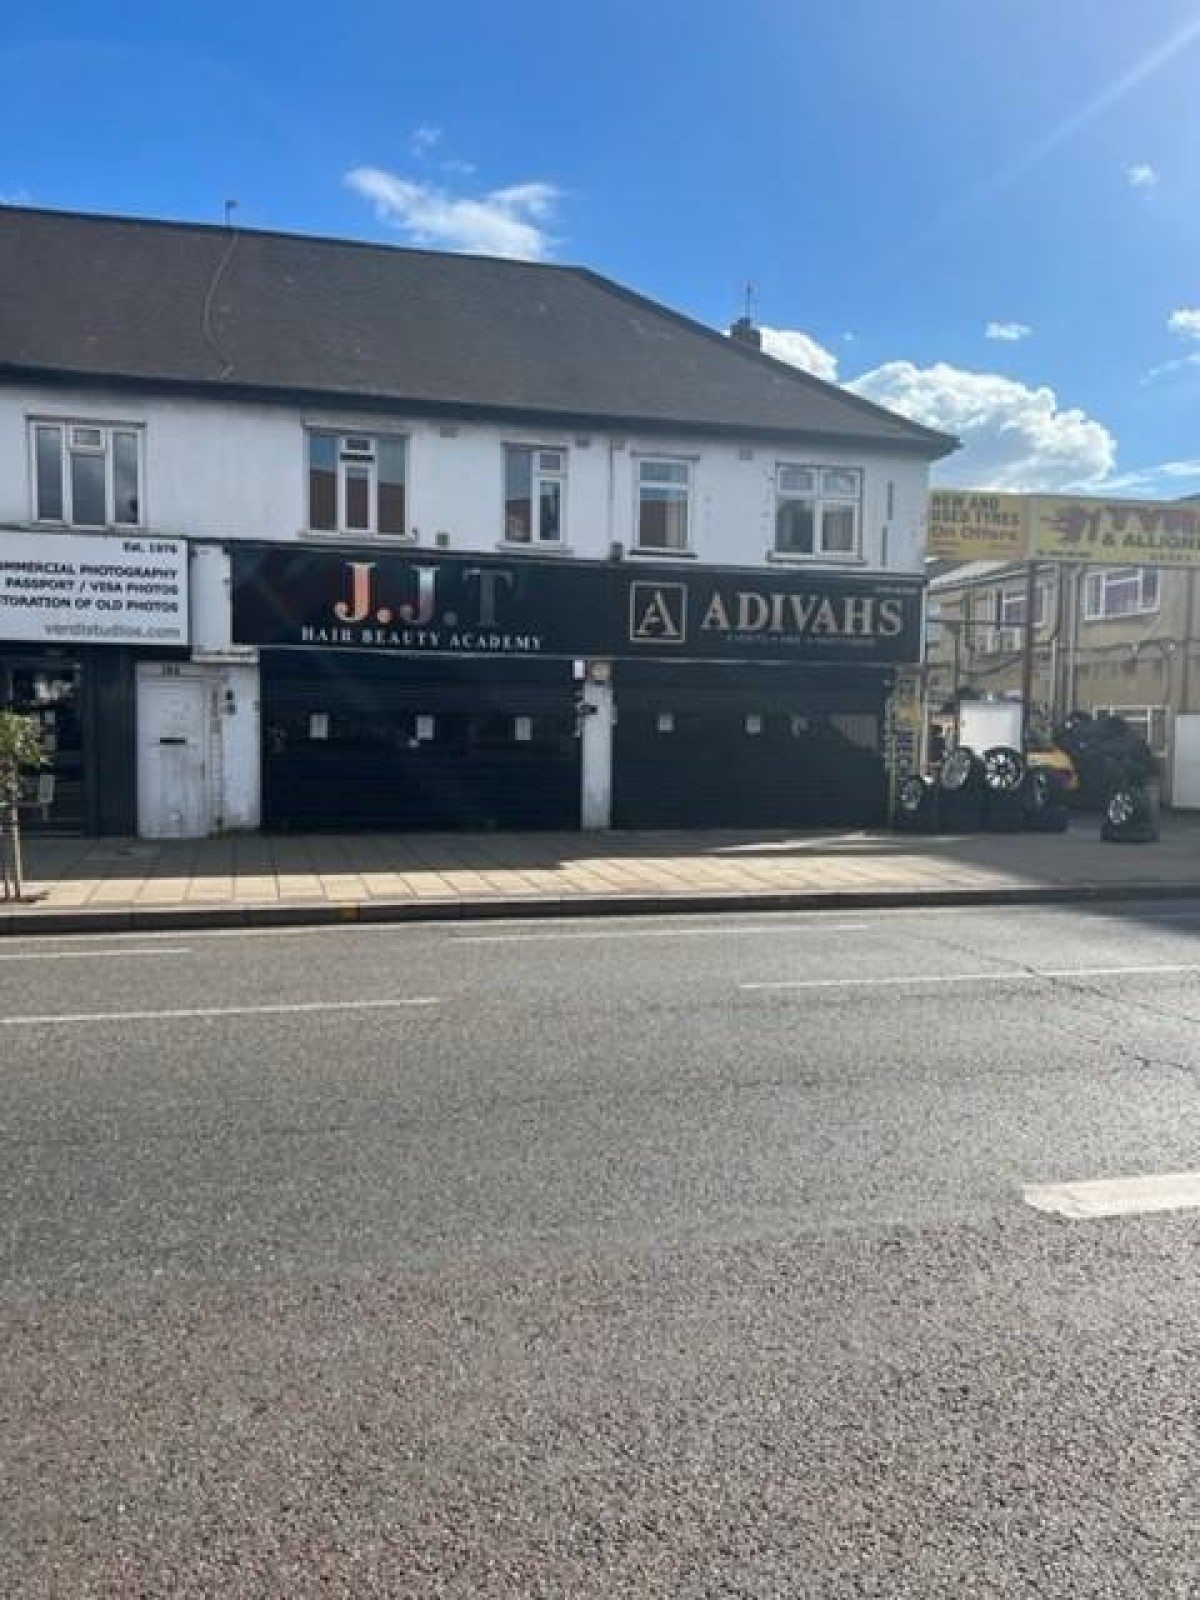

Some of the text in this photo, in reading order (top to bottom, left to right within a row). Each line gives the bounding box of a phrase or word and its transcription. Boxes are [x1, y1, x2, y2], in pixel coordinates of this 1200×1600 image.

[80, 565, 178, 580] PHOTOGRAPHY
[5, 577, 75, 591] PASSPORT
[89, 580, 122, 593] VISA
[127, 583, 178, 595] PHOTOS
[75, 597, 92, 611] OF
[95, 598, 123, 612] OLD
[127, 600, 178, 612] PHOTOS
[701, 591, 904, 637] ADIVAHS
[301, 625, 541, 651] HAIR BEAUTY ACADEMY
